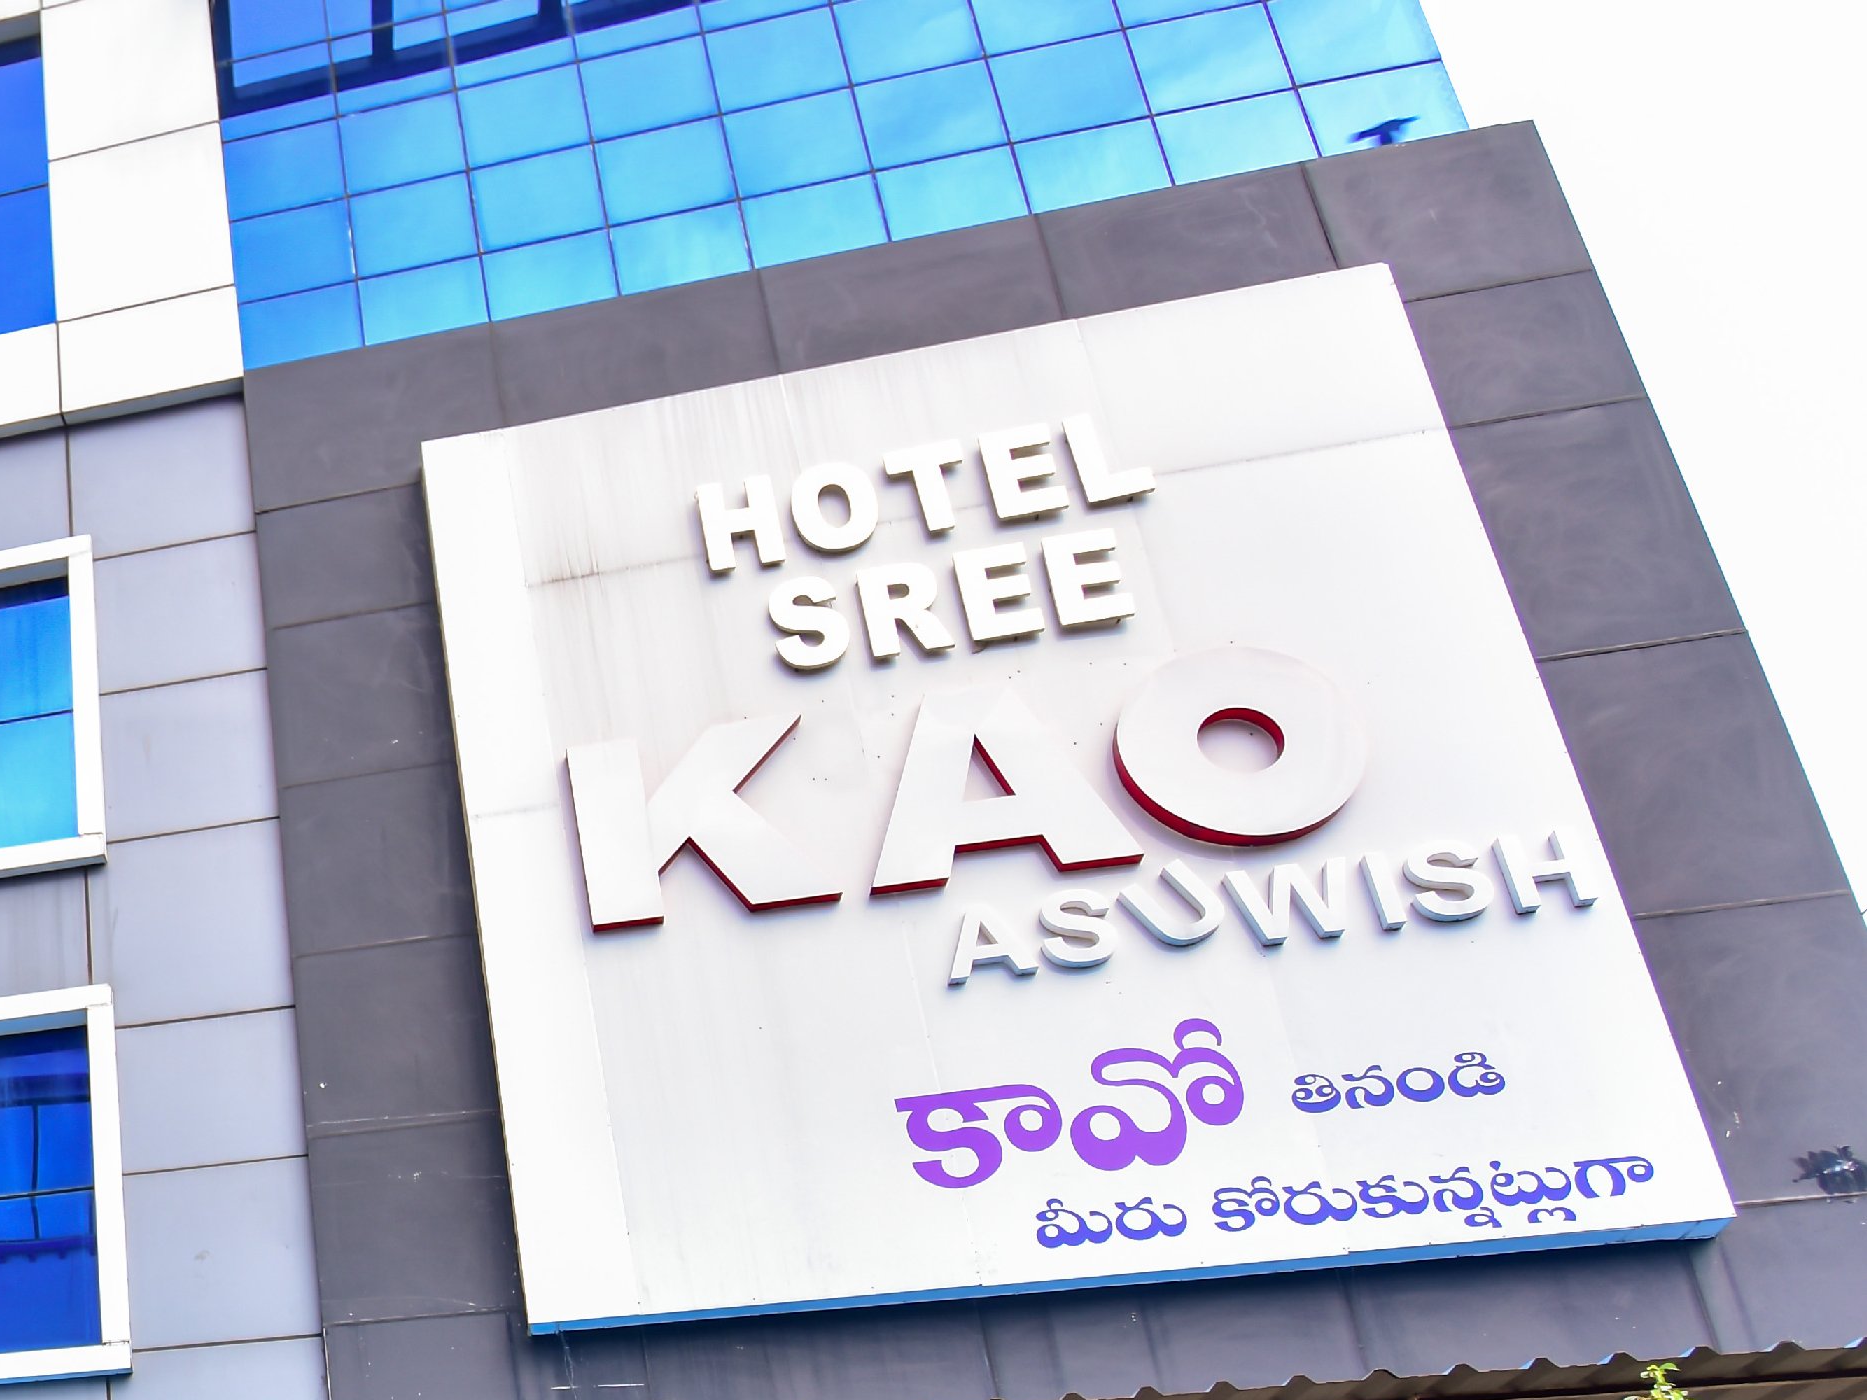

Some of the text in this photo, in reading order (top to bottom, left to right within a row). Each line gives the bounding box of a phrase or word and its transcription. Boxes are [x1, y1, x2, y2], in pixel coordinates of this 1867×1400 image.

[696, 413, 1155, 576] HOTEL
[767, 527, 1135, 673] SREE
[566, 643, 1369, 932] KAO
[946, 829, 1600, 987] ASUWISH
[1291, 1051, 1507, 1114] తినండి
[1036, 1199, 1187, 1249] మీరు
